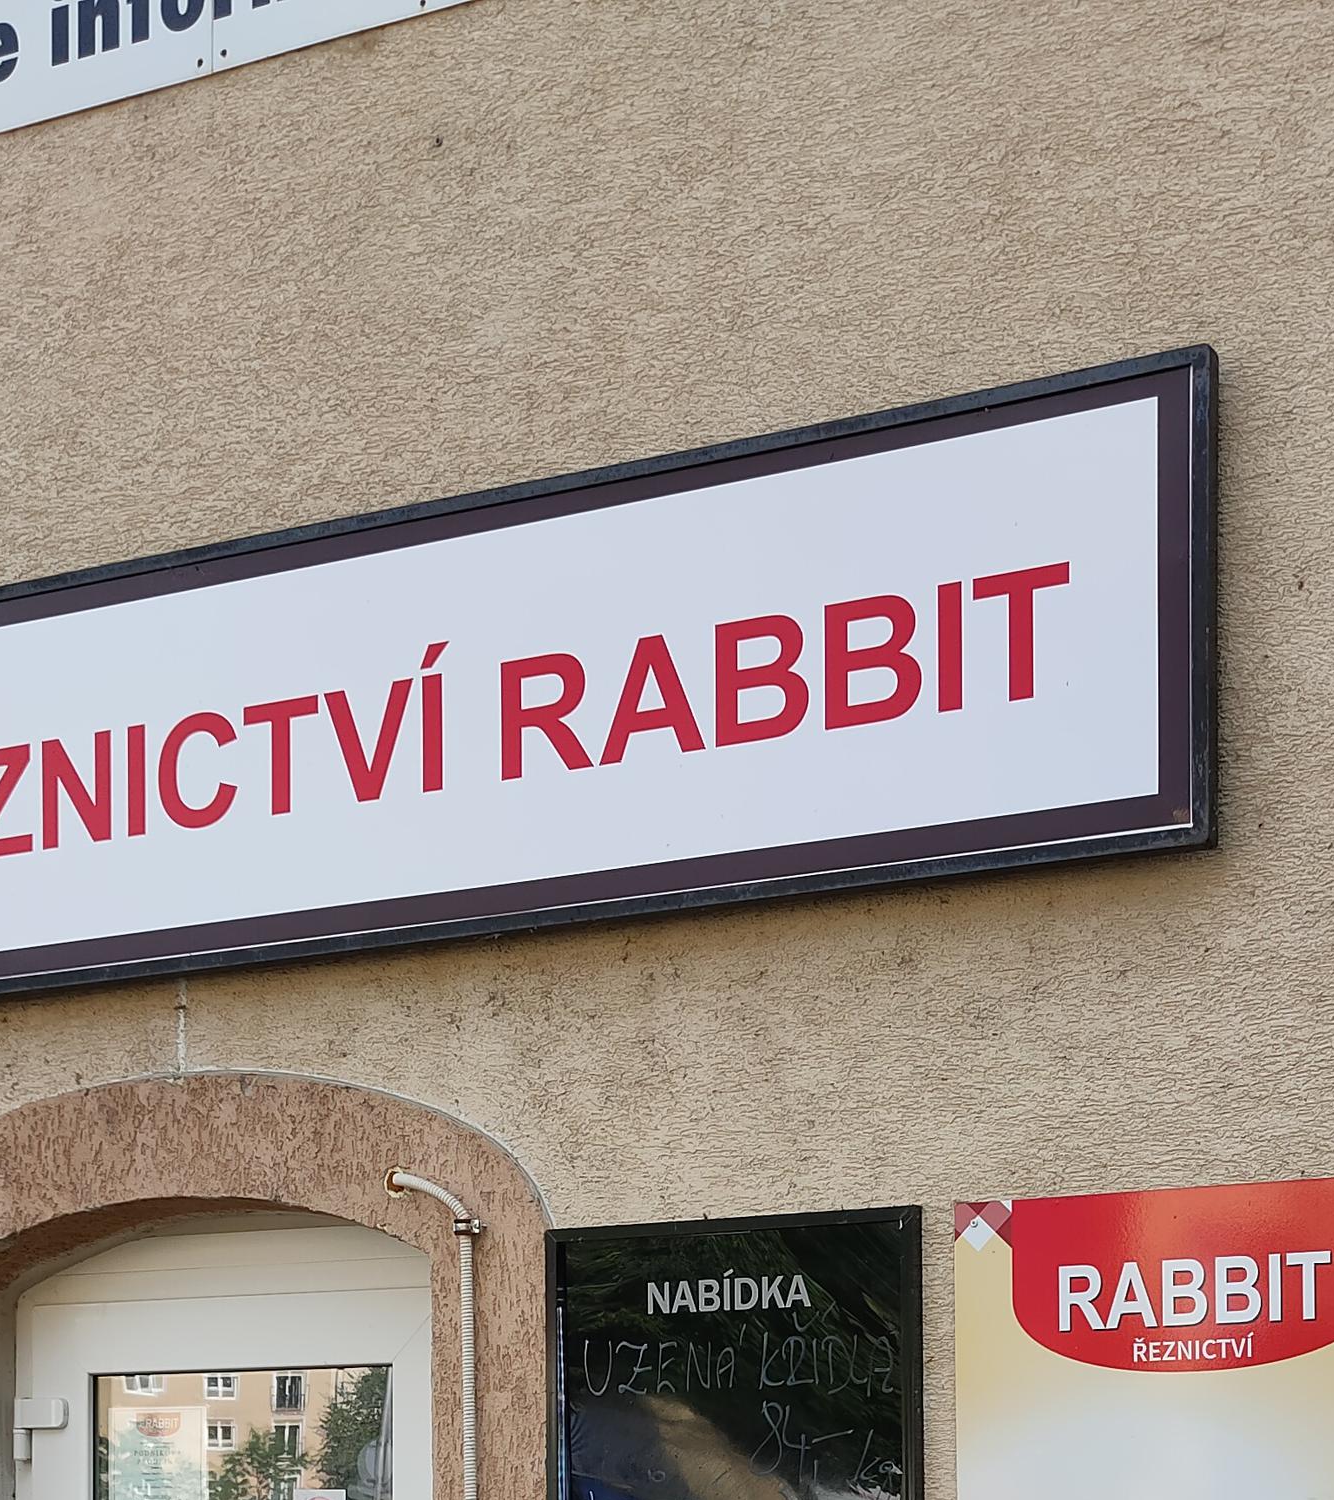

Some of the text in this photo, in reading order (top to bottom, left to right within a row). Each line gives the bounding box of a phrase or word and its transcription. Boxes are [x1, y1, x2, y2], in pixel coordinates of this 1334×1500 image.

[500, 561, 1071, 782] RABBIT
[646, 1268, 812, 1315] NABÍDKA
[1057, 1250, 1333, 1333] RABBIT
[1131, 1332, 1255, 1363] ŘEZNICTVÍ
